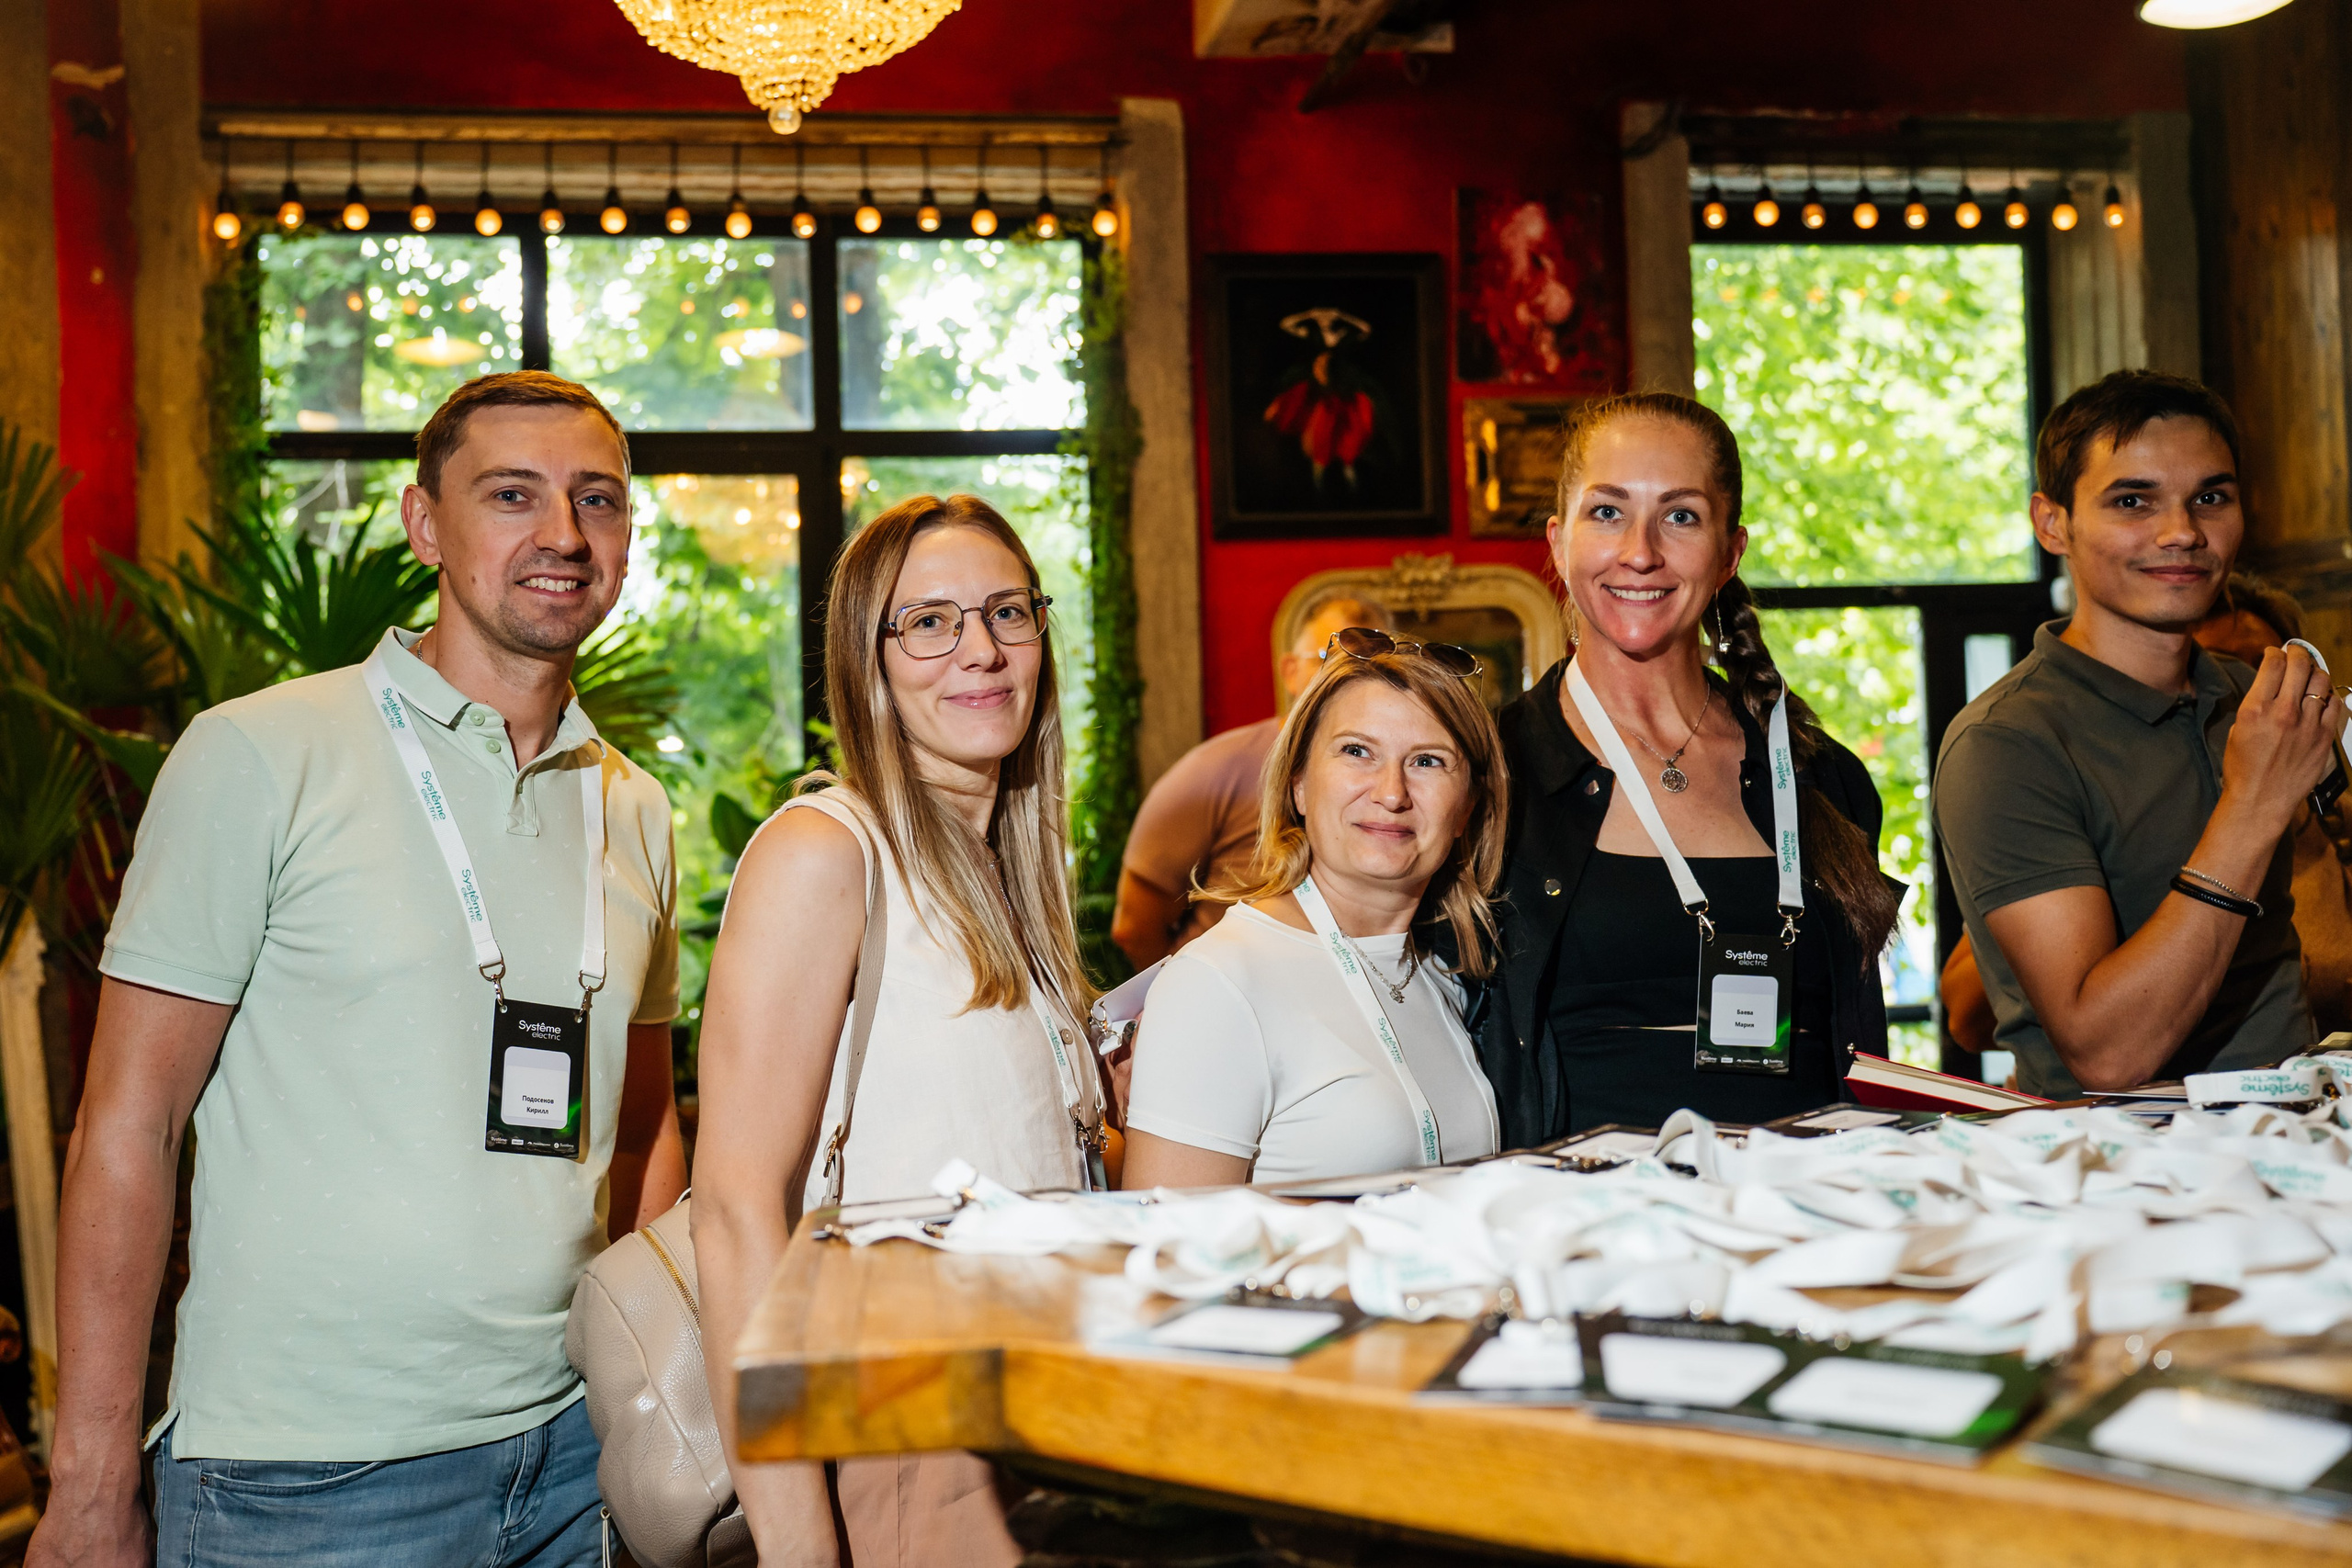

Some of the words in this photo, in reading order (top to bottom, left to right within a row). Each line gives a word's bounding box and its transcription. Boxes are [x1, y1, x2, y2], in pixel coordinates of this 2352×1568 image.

[380, 703, 398, 730] electric
[382, 687, 405, 728] Systême
[1775, 748, 1787, 790] Systême
[1781, 746, 1792, 776] electric
[420, 788, 439, 822] electric
[421, 771, 447, 820] Systême
[1782, 829, 1792, 874] Systême
[1789, 830, 1797, 861] electric
[460, 886, 477, 923] electric
[461, 868, 483, 921] Systême
[1329, 931, 1358, 975] Systême
[1331, 947, 1351, 976] electric
[1724, 949, 1769, 961] Systême
[1738, 959, 1768, 967] electric
[518, 1020, 561, 1034] Systême
[531, 1031, 561, 1041] electric
[1378, 1017, 1403, 1065] Systême
[2239, 1074, 2290, 1083] electric
[2240, 1082, 2310, 1096] Systême
[522, 1095, 555, 1105] Подосенов
[526, 1107, 549, 1115] Кирилл
[1422, 1110, 1437, 1161] Systême
